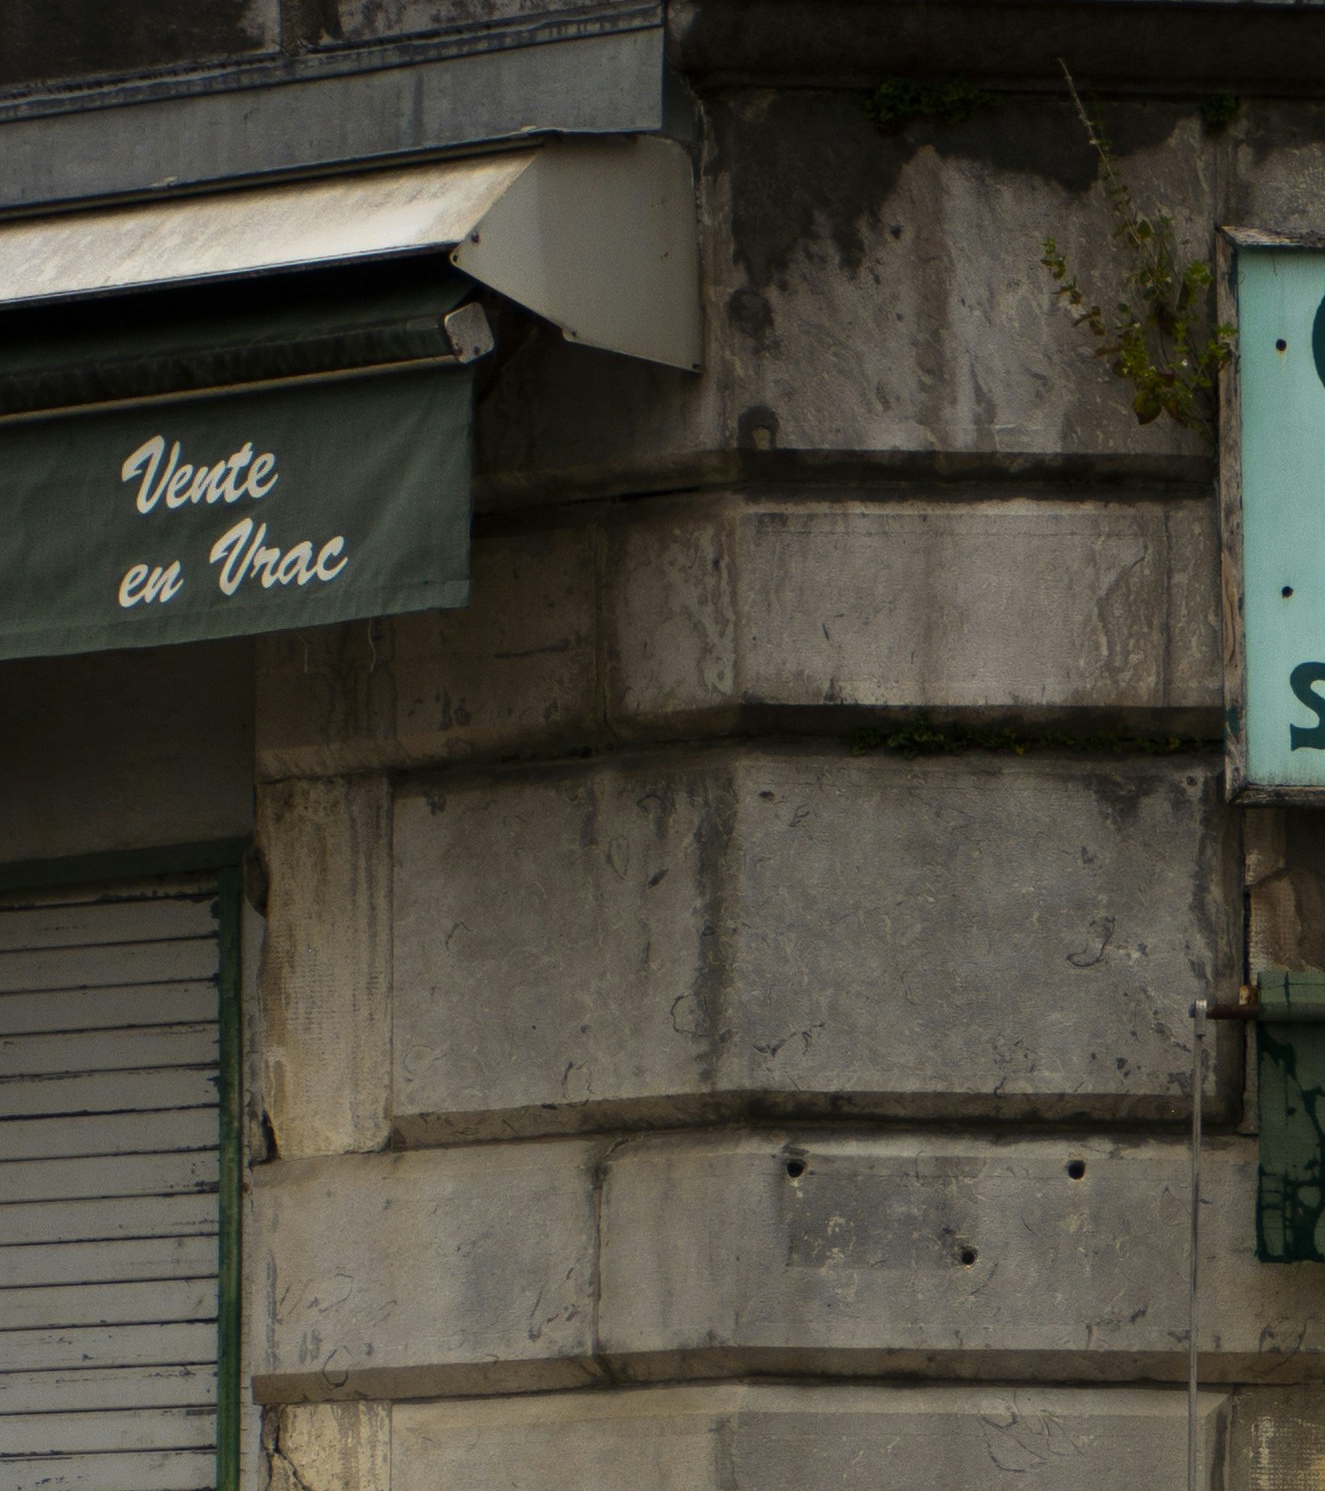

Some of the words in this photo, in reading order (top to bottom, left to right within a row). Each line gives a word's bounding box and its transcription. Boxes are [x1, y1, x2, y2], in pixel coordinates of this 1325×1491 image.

[121, 435, 278, 514] Vente
[118, 560, 184, 608] en
[209, 517, 348, 596] Vrac
